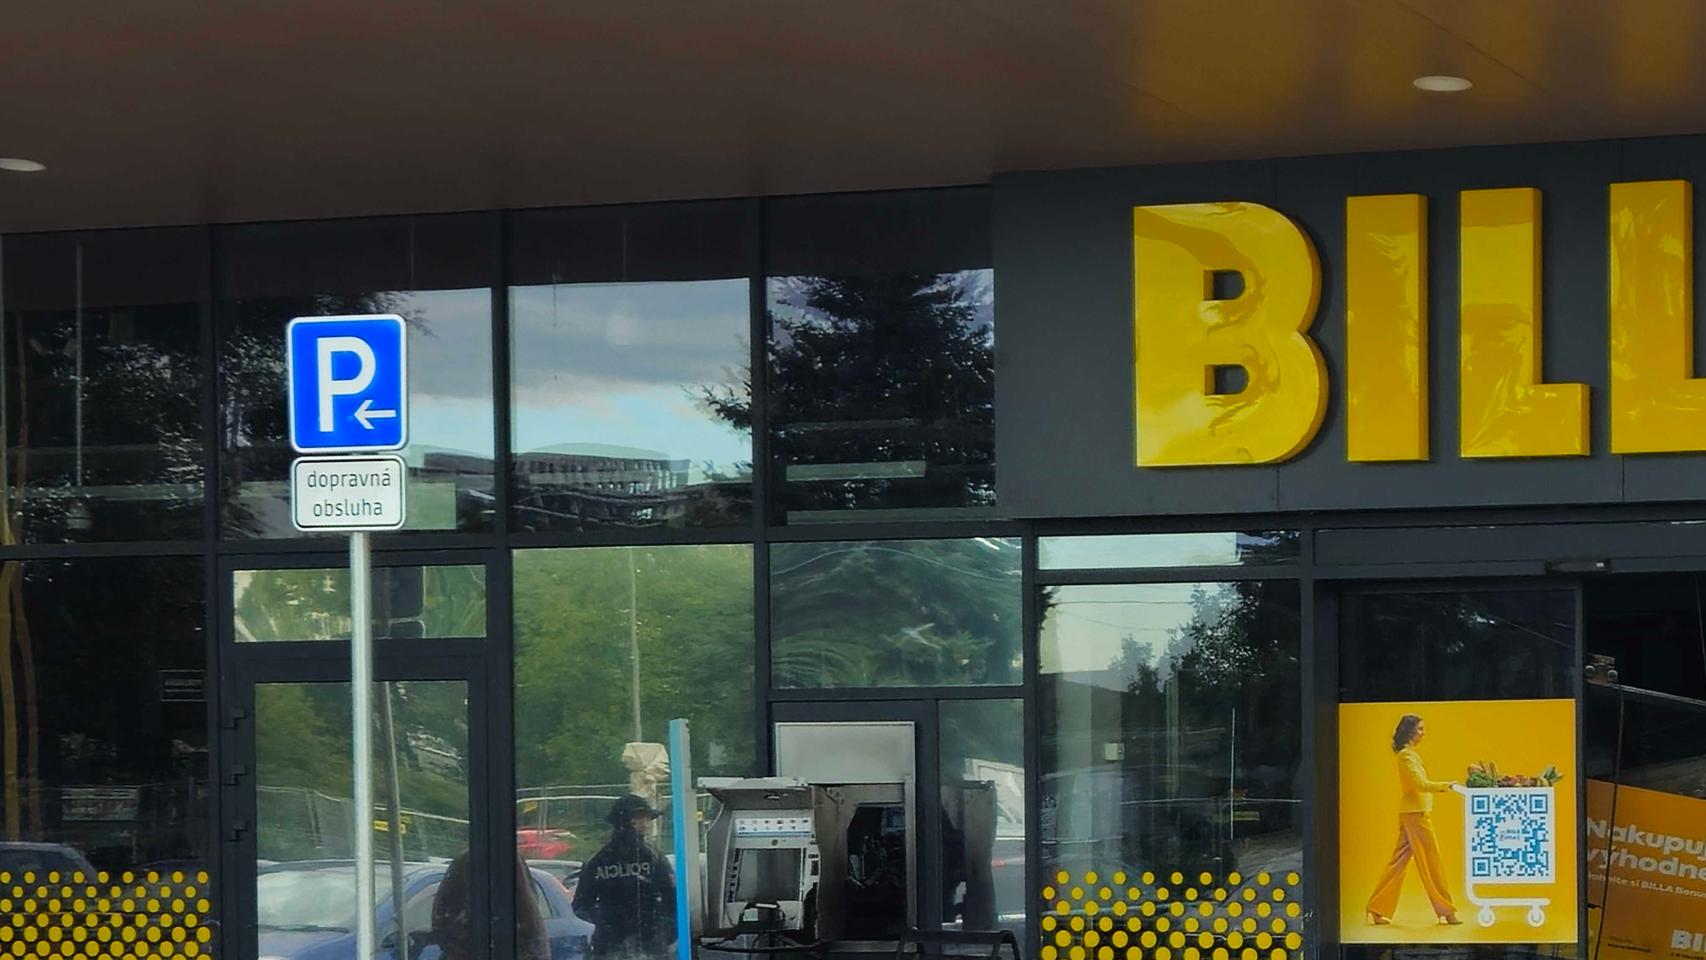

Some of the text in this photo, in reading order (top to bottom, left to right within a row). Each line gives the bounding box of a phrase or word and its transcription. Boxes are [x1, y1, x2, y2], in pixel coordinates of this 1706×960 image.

[317, 336, 376, 432] P
[306, 467, 391, 491] dopravná
[312, 498, 383, 517] obsluha
